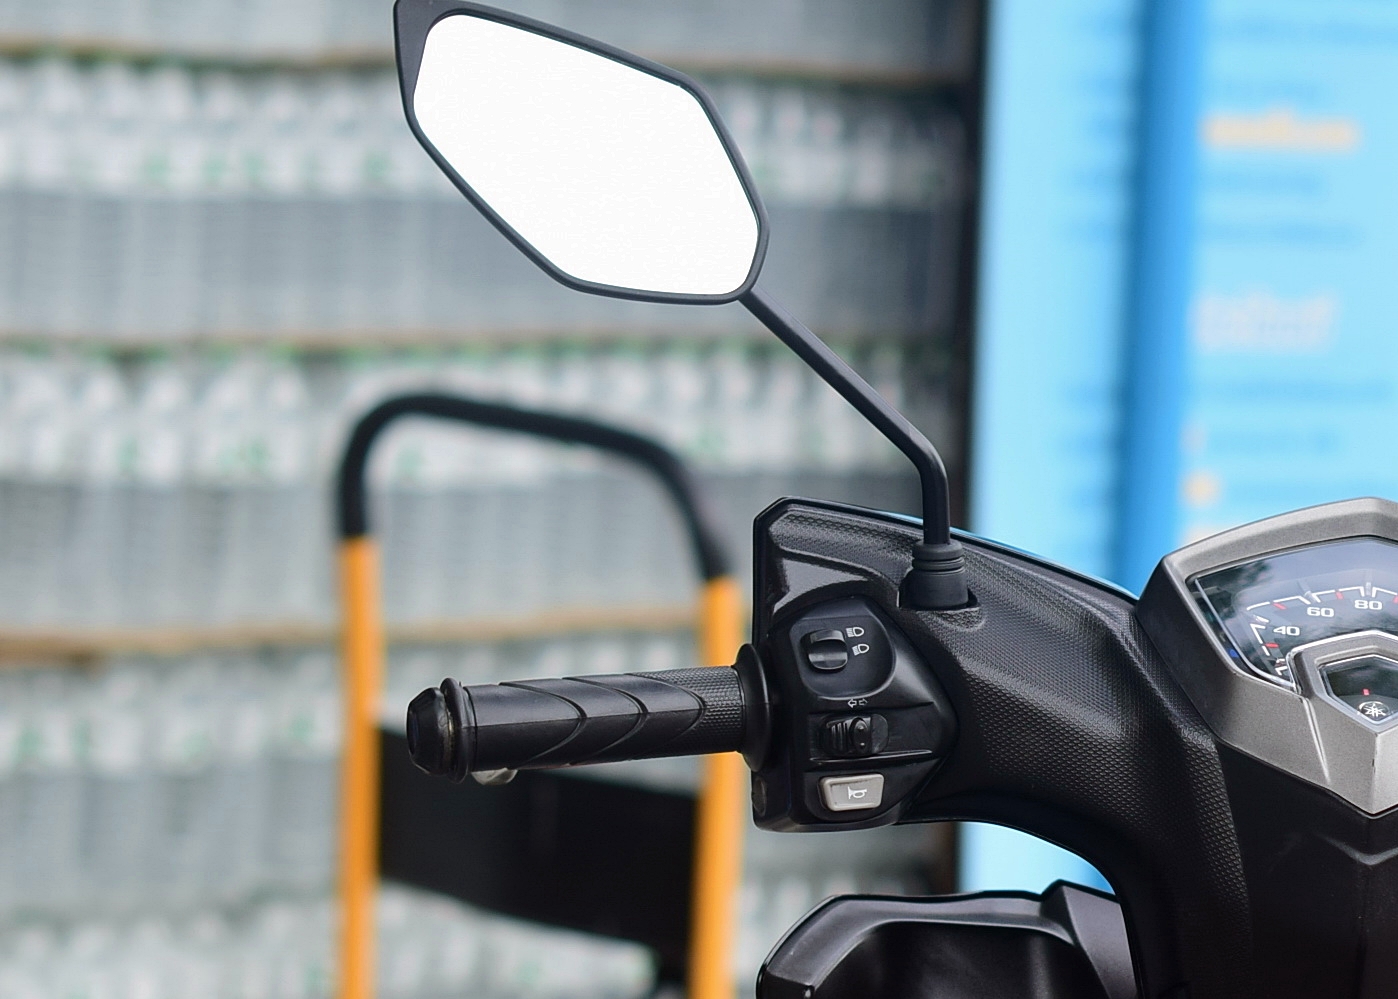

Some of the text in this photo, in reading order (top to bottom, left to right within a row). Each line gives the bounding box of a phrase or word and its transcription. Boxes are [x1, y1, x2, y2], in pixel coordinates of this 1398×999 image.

[1354, 599, 1382, 610] 80
[1306, 606, 1335, 617] 60
[1273, 625, 1301, 637] 40
